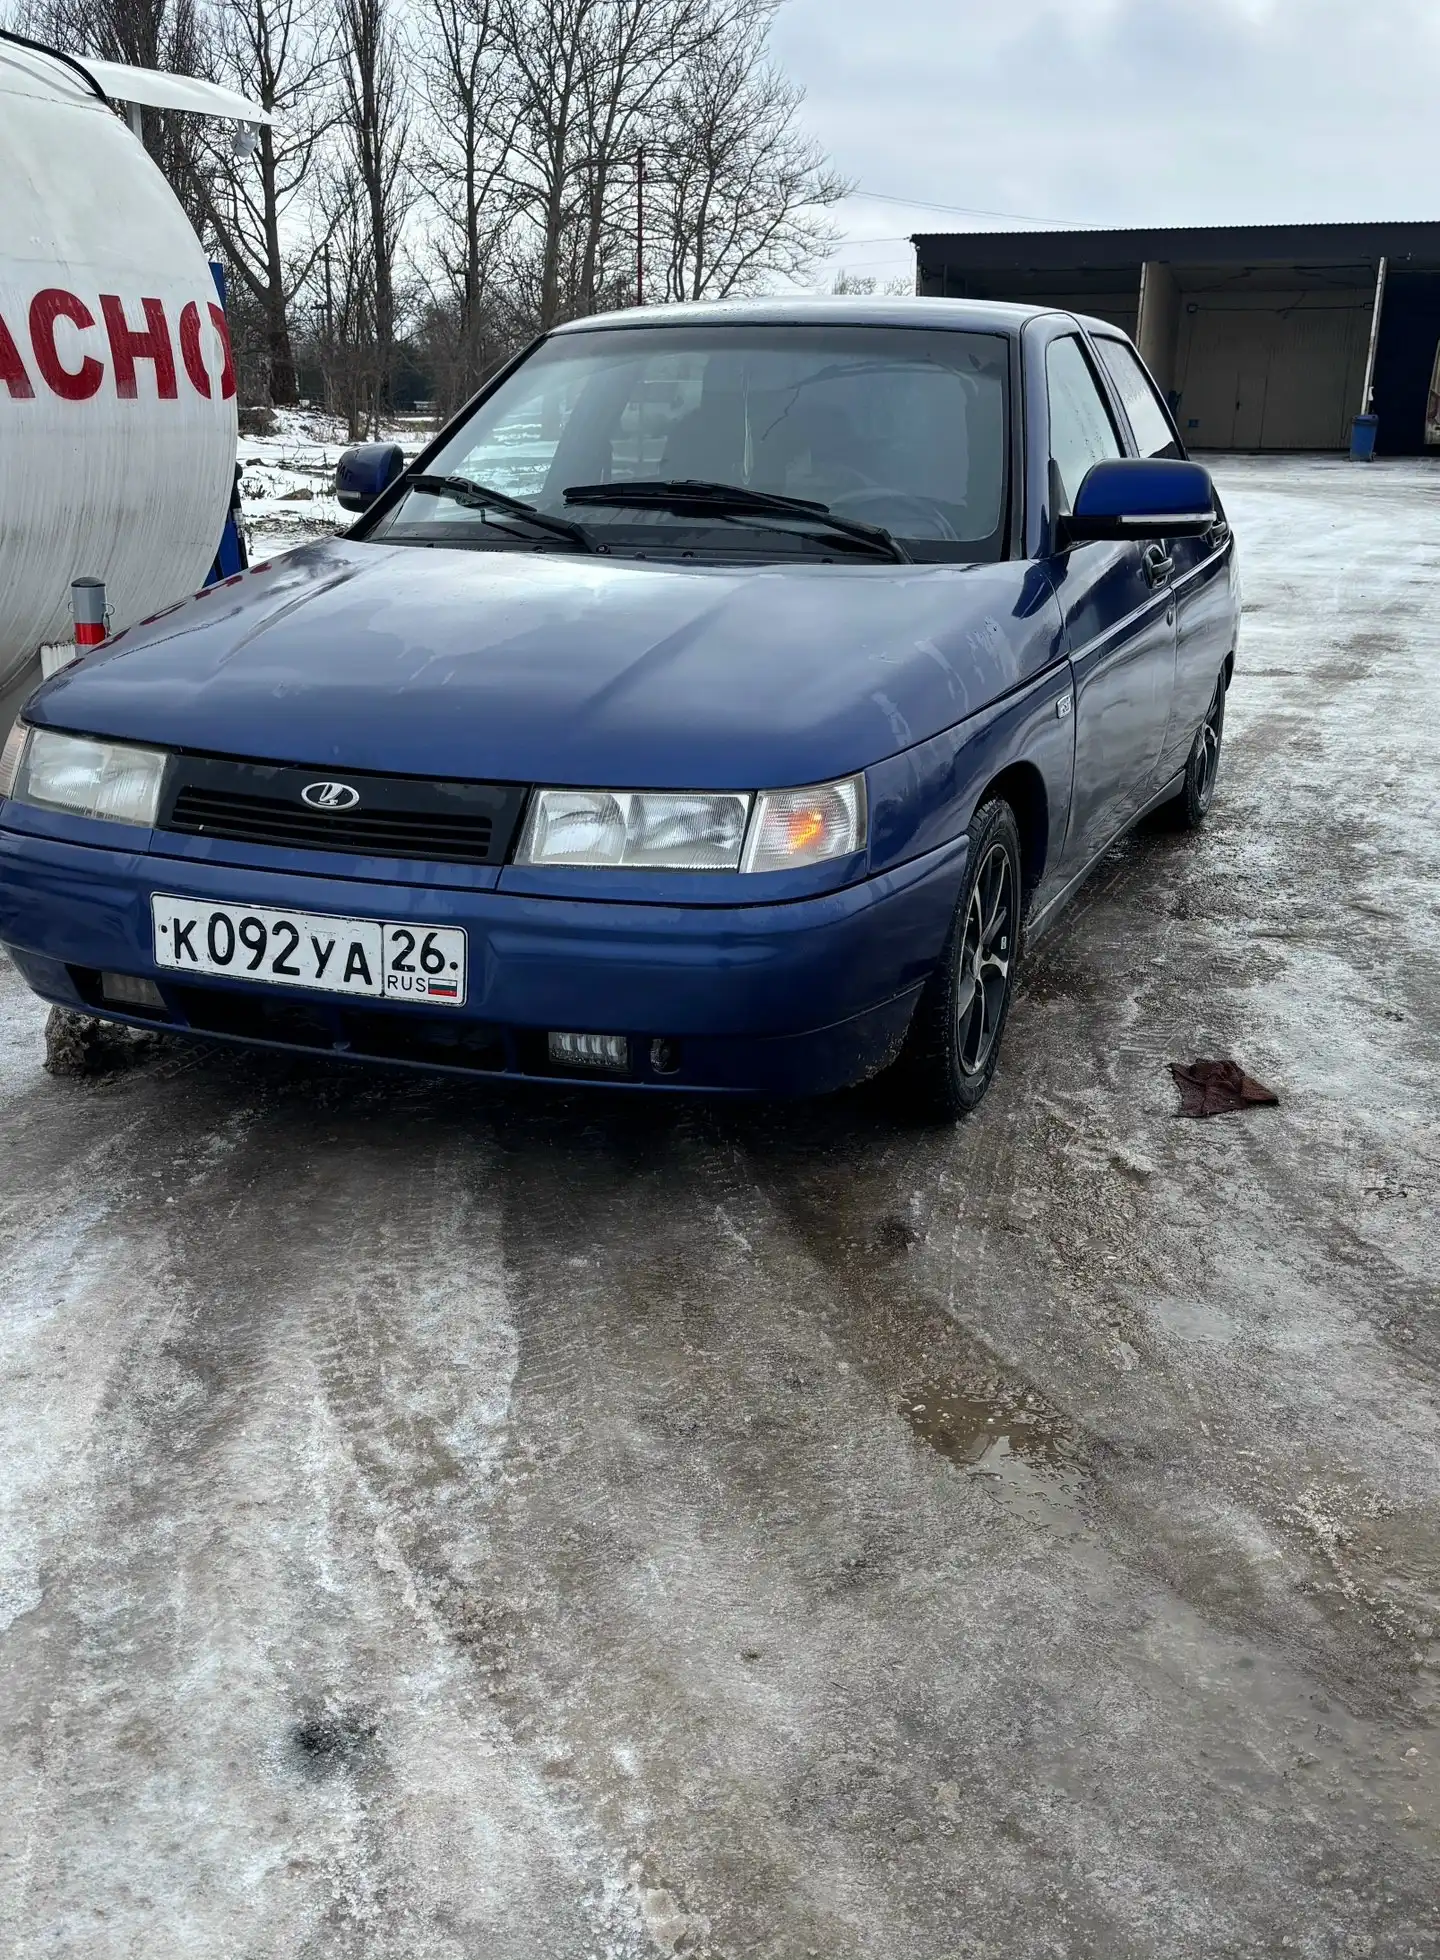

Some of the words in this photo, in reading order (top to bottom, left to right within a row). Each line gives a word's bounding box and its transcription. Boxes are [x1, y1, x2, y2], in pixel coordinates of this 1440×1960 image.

[173, 911, 373, 986] К092УА
[391, 929, 446, 975] 26
[387, 974, 427, 993] RUS
